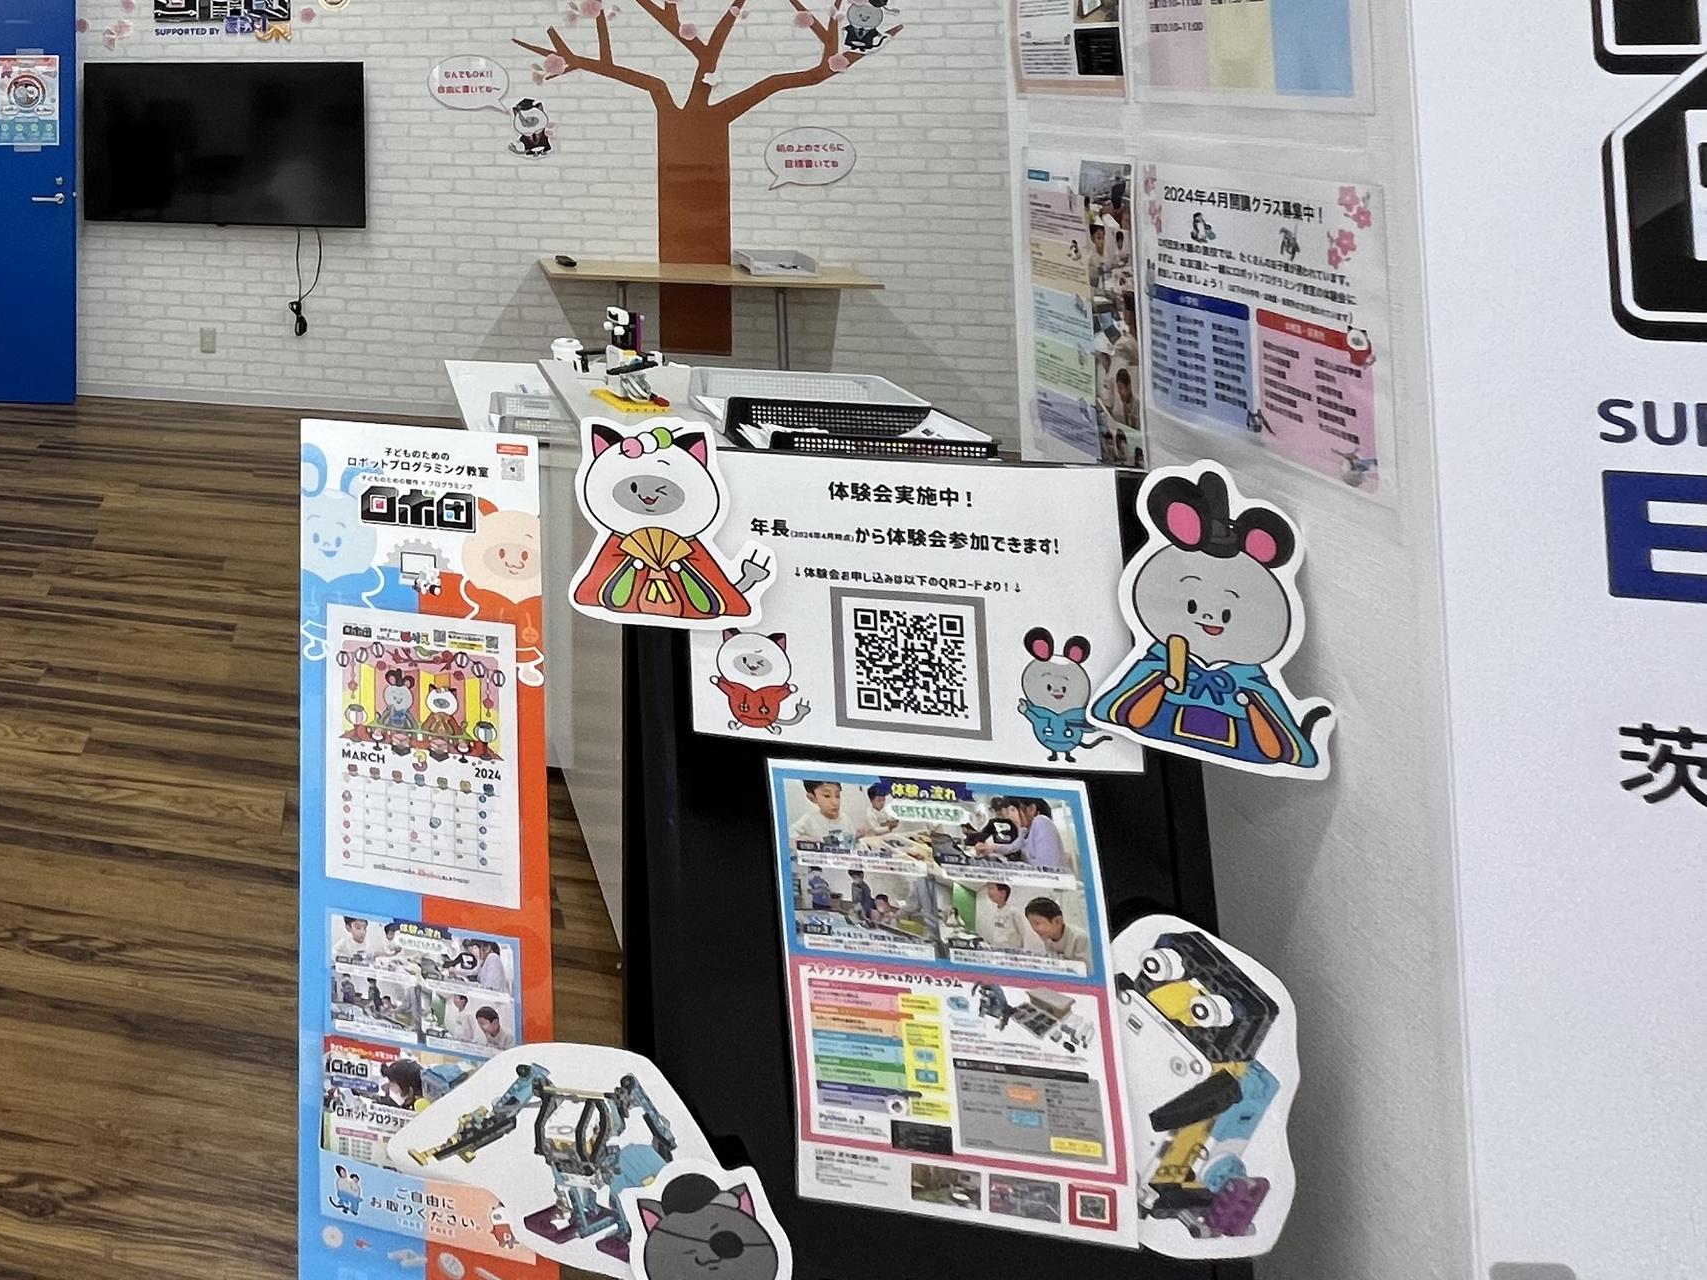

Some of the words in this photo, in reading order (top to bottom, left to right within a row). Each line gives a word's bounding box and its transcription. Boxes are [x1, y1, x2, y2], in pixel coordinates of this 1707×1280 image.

[384, 448, 450, 461] 子どものための
[347, 457, 490, 478] ロボットプログラミング教室
[828, 480, 974, 508] 体験会実施中!
[341, 748, 386, 766] MARCH
[474, 766, 502, 781] 2024
[396, 1187, 454, 1210] ご自由に
[369, 1197, 482, 1231] お取りください。
